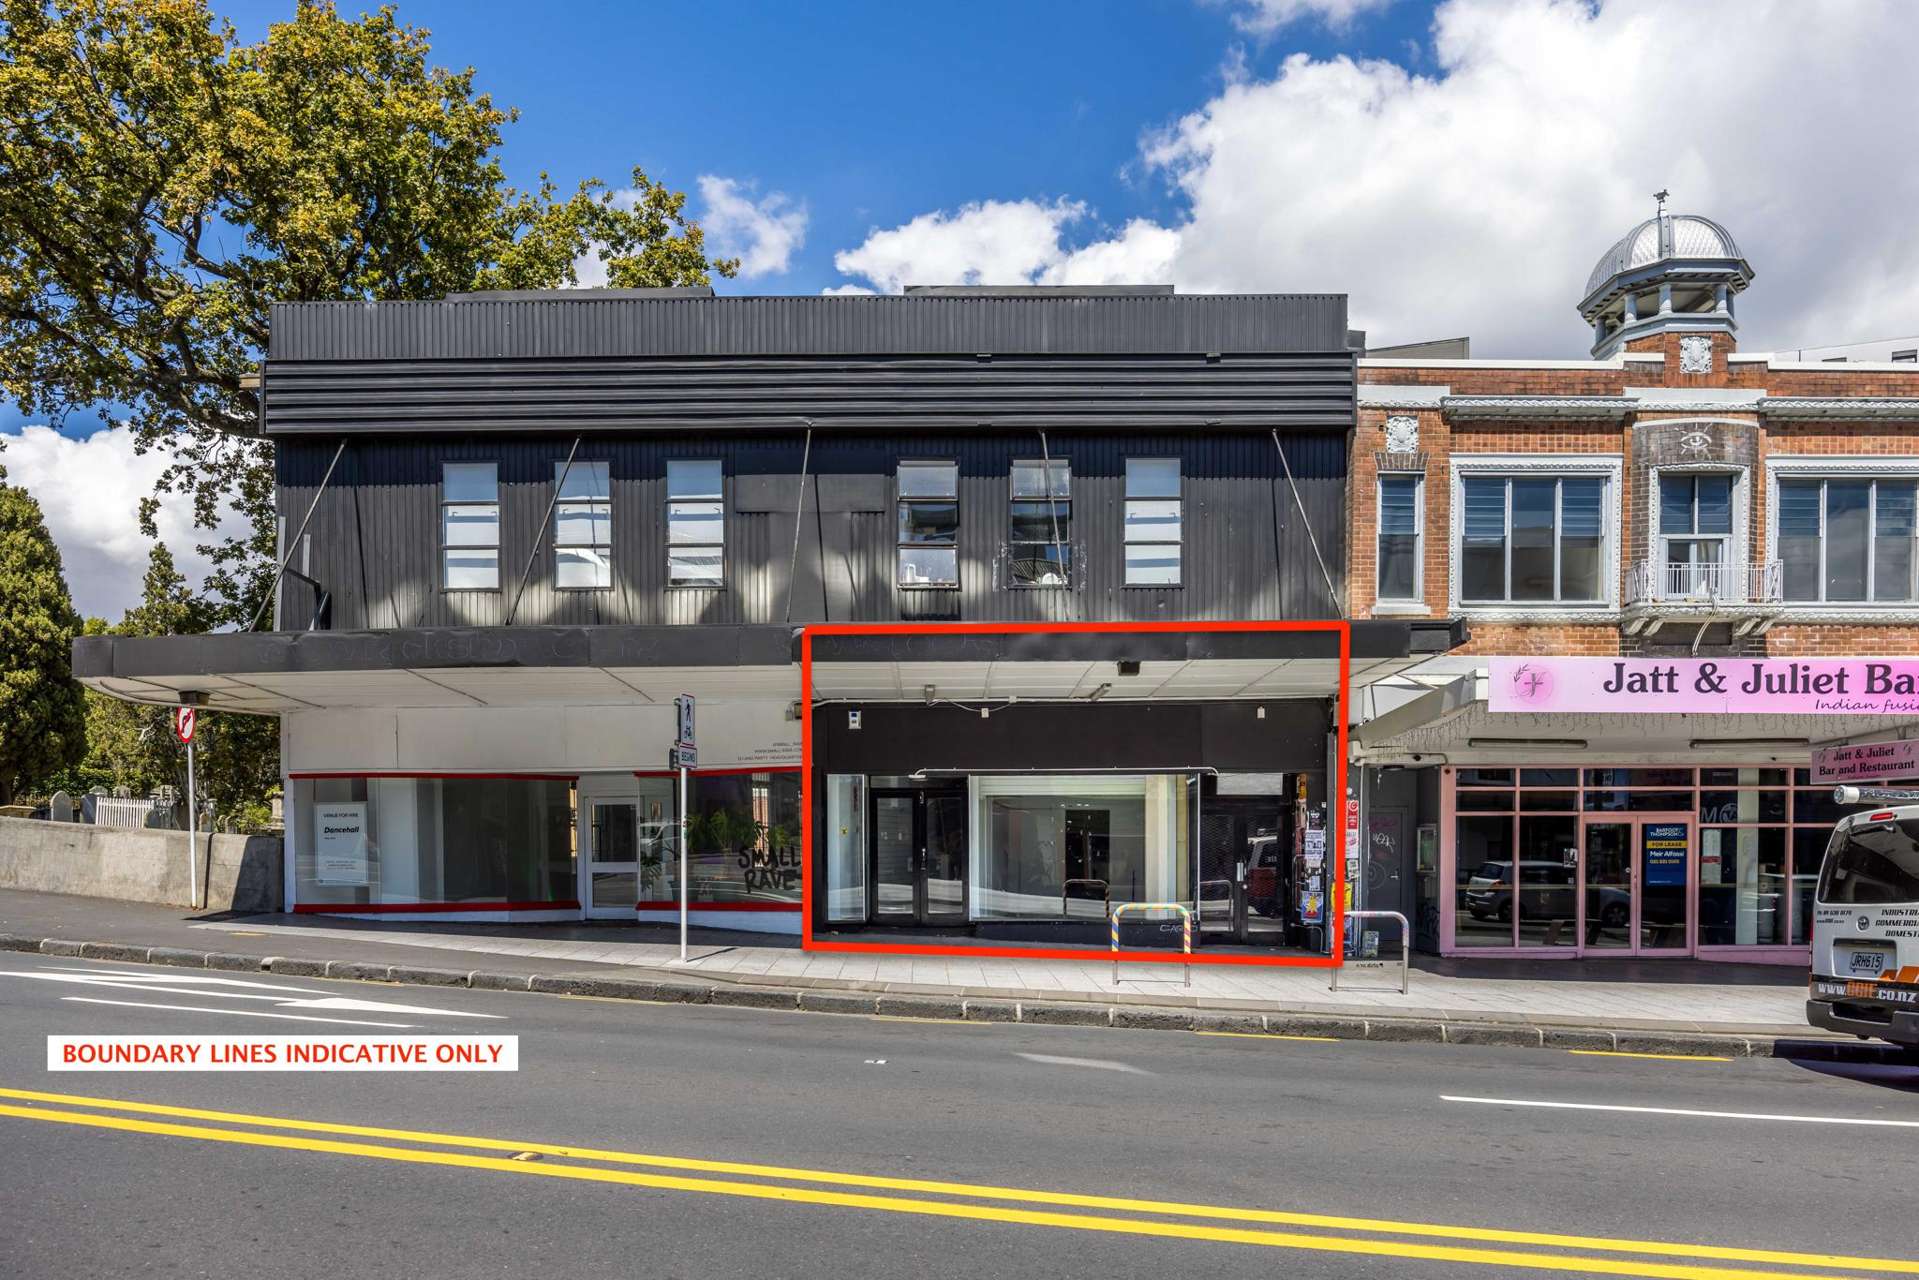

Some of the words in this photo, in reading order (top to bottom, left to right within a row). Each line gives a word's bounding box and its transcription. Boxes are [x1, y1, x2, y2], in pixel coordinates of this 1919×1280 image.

[1603, 662, 1680, 694] Jatt
[1694, 663, 1728, 694] &
[1741, 663, 1850, 695] Juliet
[1864, 663, 1919, 695] Ba
[1815, 698, 1879, 711] Indian
[1833, 750, 1853, 761] Jatt
[1855, 748, 1865, 759] &
[1866, 746, 1895, 759] Juliet
[1819, 765, 1836, 776] Bar
[1838, 763, 1857, 774] and
[1859, 759, 1915, 773] Restaurant
[323, 826, 360, 834] Dancehall
[738, 846, 802, 869] SMALL
[744, 868, 800, 894] RAVE
[1881, 908, 1919, 916] INDUSTRI
